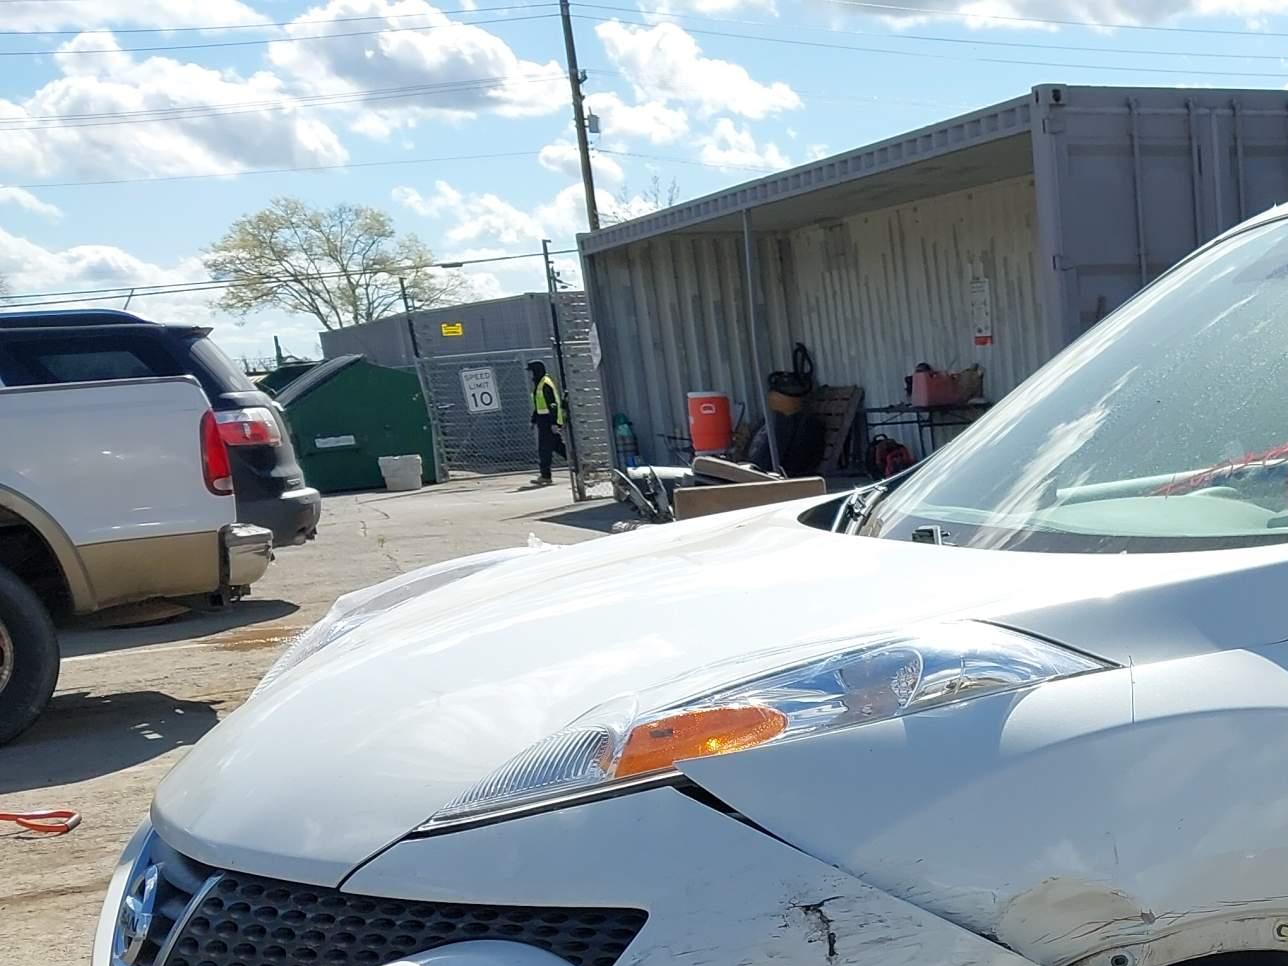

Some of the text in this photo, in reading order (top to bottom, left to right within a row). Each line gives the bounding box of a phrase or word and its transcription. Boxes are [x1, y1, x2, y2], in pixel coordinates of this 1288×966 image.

[464, 372, 490, 381] SPEED
[469, 381, 489, 390] LIMIT
[471, 391, 493, 408] 10
